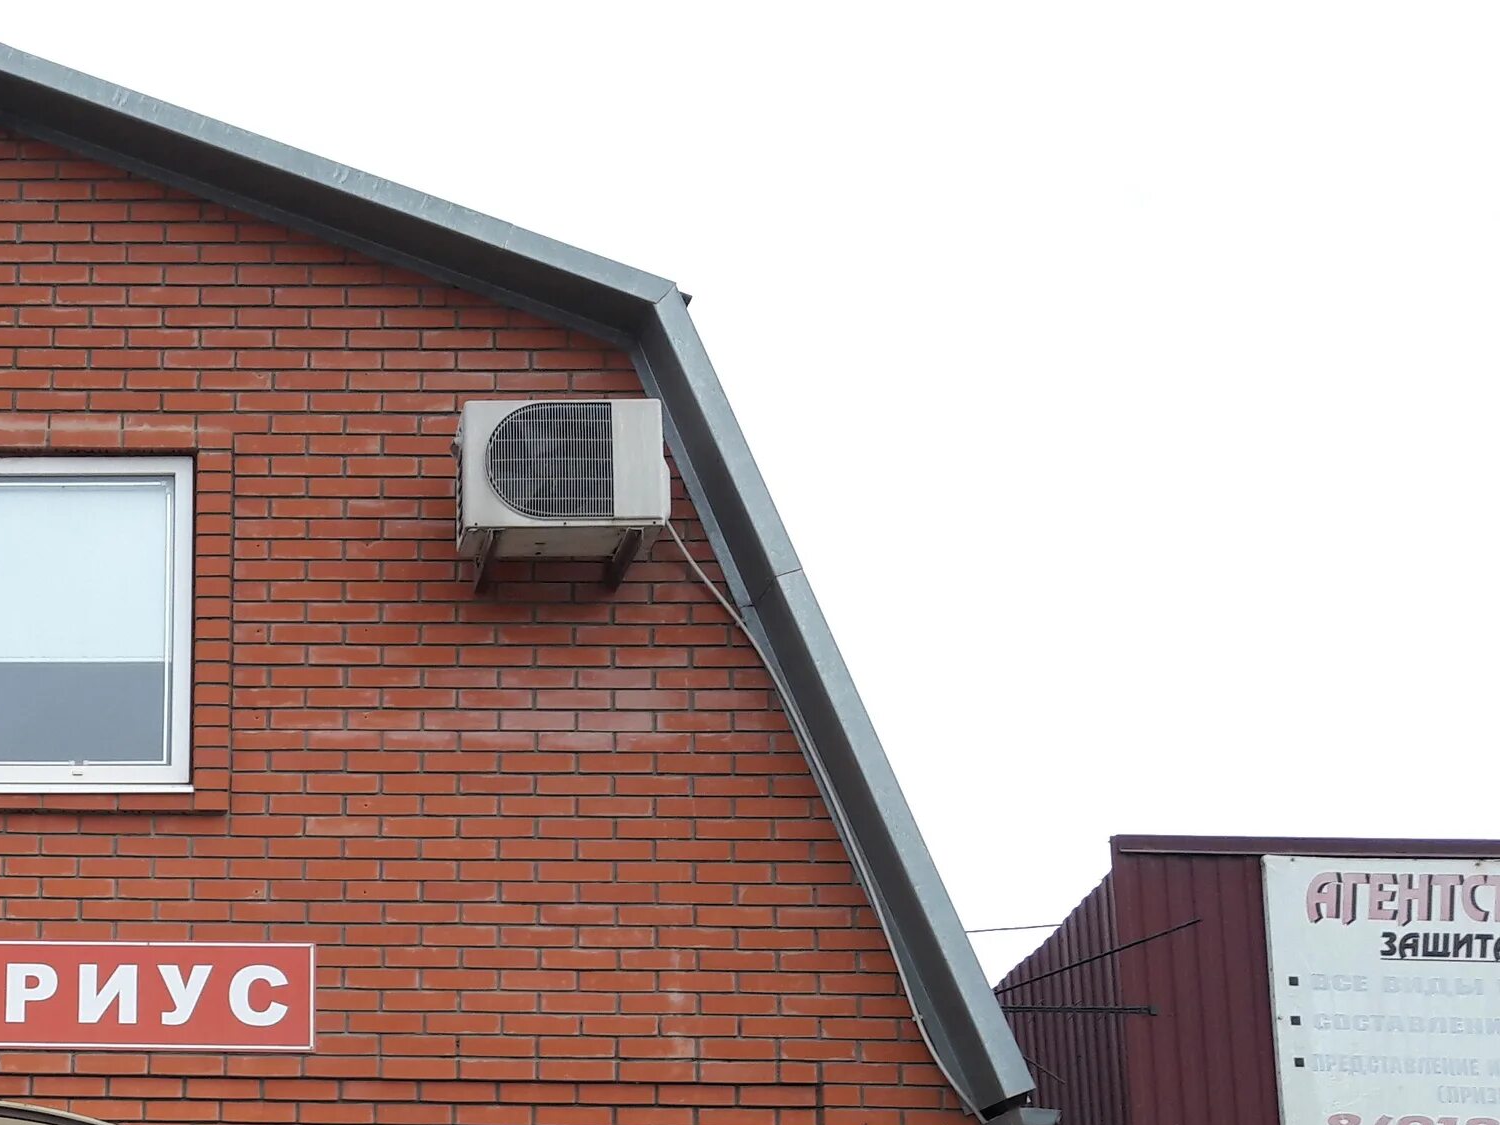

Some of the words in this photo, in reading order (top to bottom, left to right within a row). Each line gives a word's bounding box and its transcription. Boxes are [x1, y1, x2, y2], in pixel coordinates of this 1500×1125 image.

[1310, 973, 1368, 992] ВСЕ
[1383, 976, 1484, 996] ВИДЫ
[1437, 1085, 1500, 1105] (ПРИЗ
